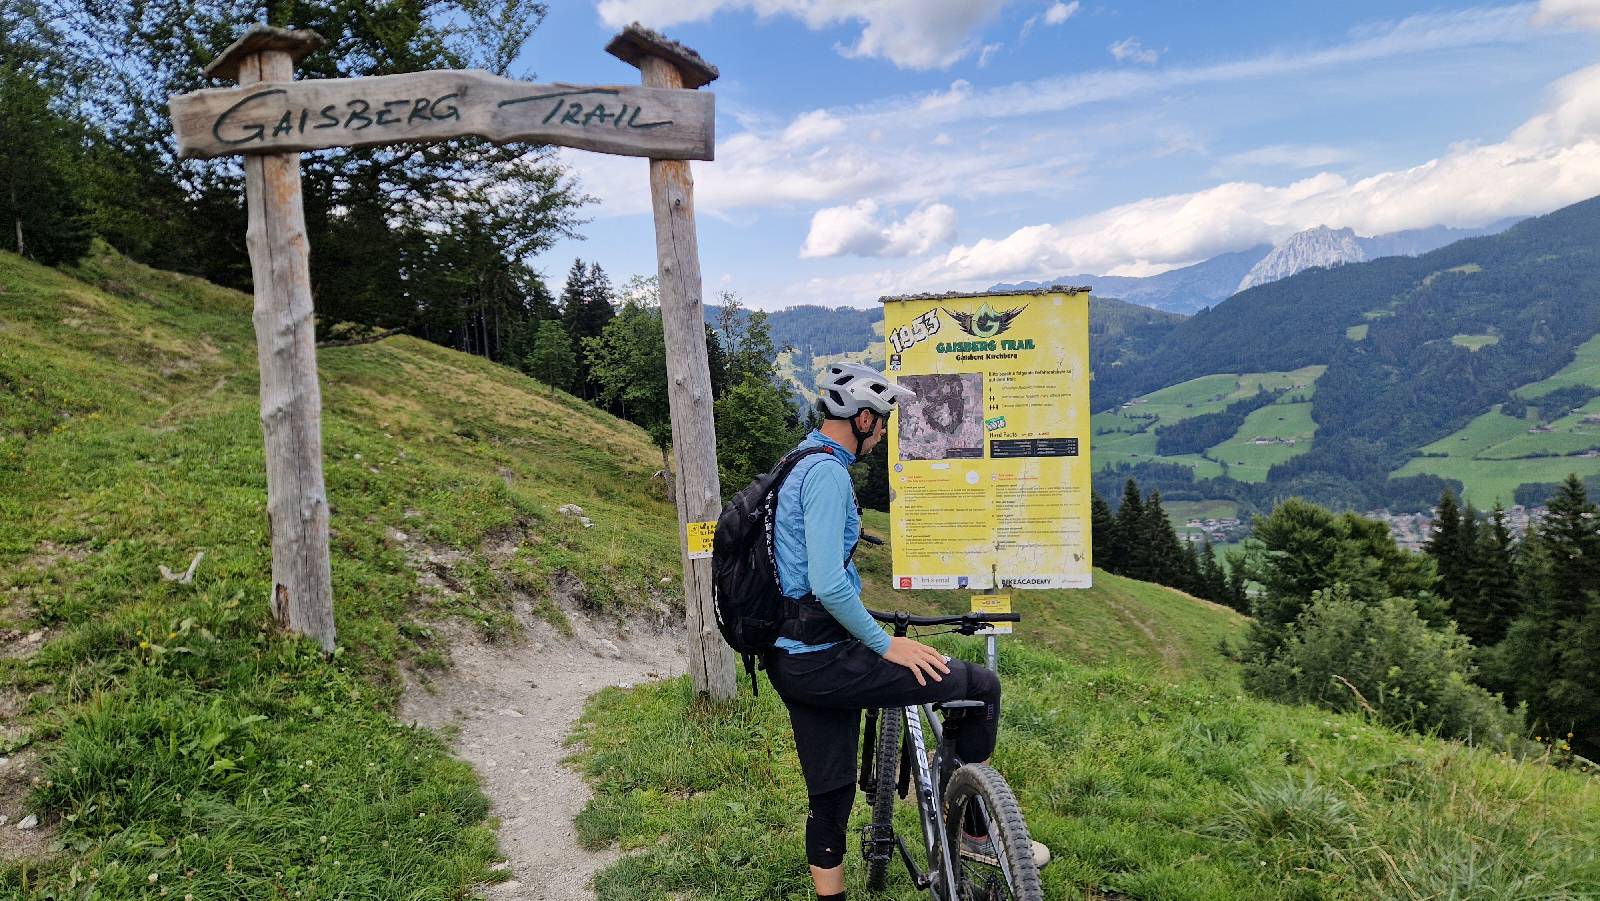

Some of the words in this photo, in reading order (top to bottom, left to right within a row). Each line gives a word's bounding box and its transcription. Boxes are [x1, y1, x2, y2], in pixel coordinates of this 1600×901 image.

[212, 88, 461, 144] GAISBERG
[499, 89, 673, 130] TRAIL
[889, 308, 940, 353] 1953
[936, 340, 996, 353] GAISBERG
[1001, 339, 1035, 350] TRAIL
